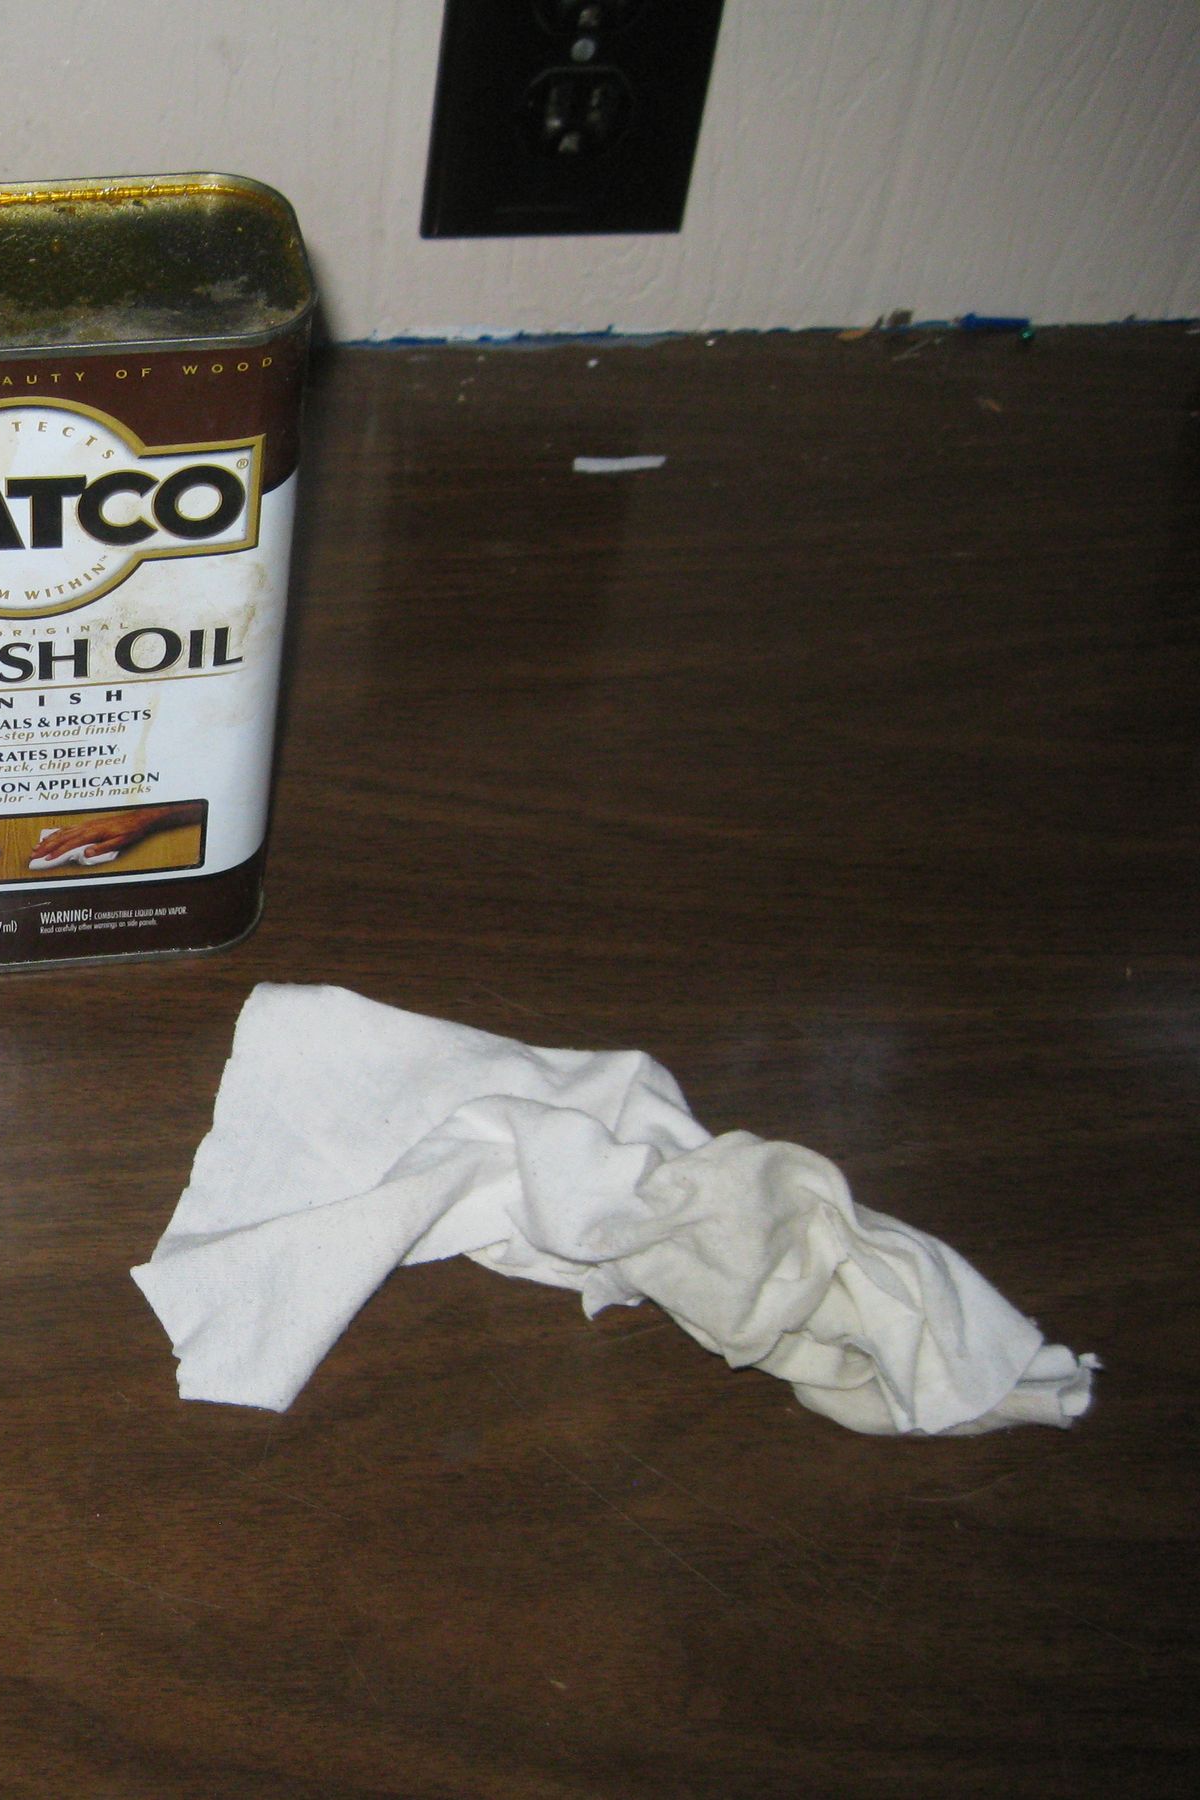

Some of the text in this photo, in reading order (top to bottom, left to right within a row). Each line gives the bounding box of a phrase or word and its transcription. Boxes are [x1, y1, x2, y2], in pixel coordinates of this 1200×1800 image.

[116, 367, 152, 379] OF
[182, 356, 274, 376] WOOD
[114, 626, 244, 675] OIL
[38, 716, 50, 728] &
[56, 709, 152, 727] PROTECTS
[40, 726, 81, 739] wood
[84, 723, 127, 736] finish
[53, 744, 118, 759] DEEPLY
[39, 760, 71, 772] chip
[75, 760, 92, 769] or
[94, 754, 127, 769] peel
[36, 771, 160, 791] APPLICATION
[38, 791, 59, 801] No
[63, 787, 104, 800] brush
[108, 784, 152, 796] marks
[40, 908, 92, 925] WARNING!
[154, 907, 167, 917] AND
